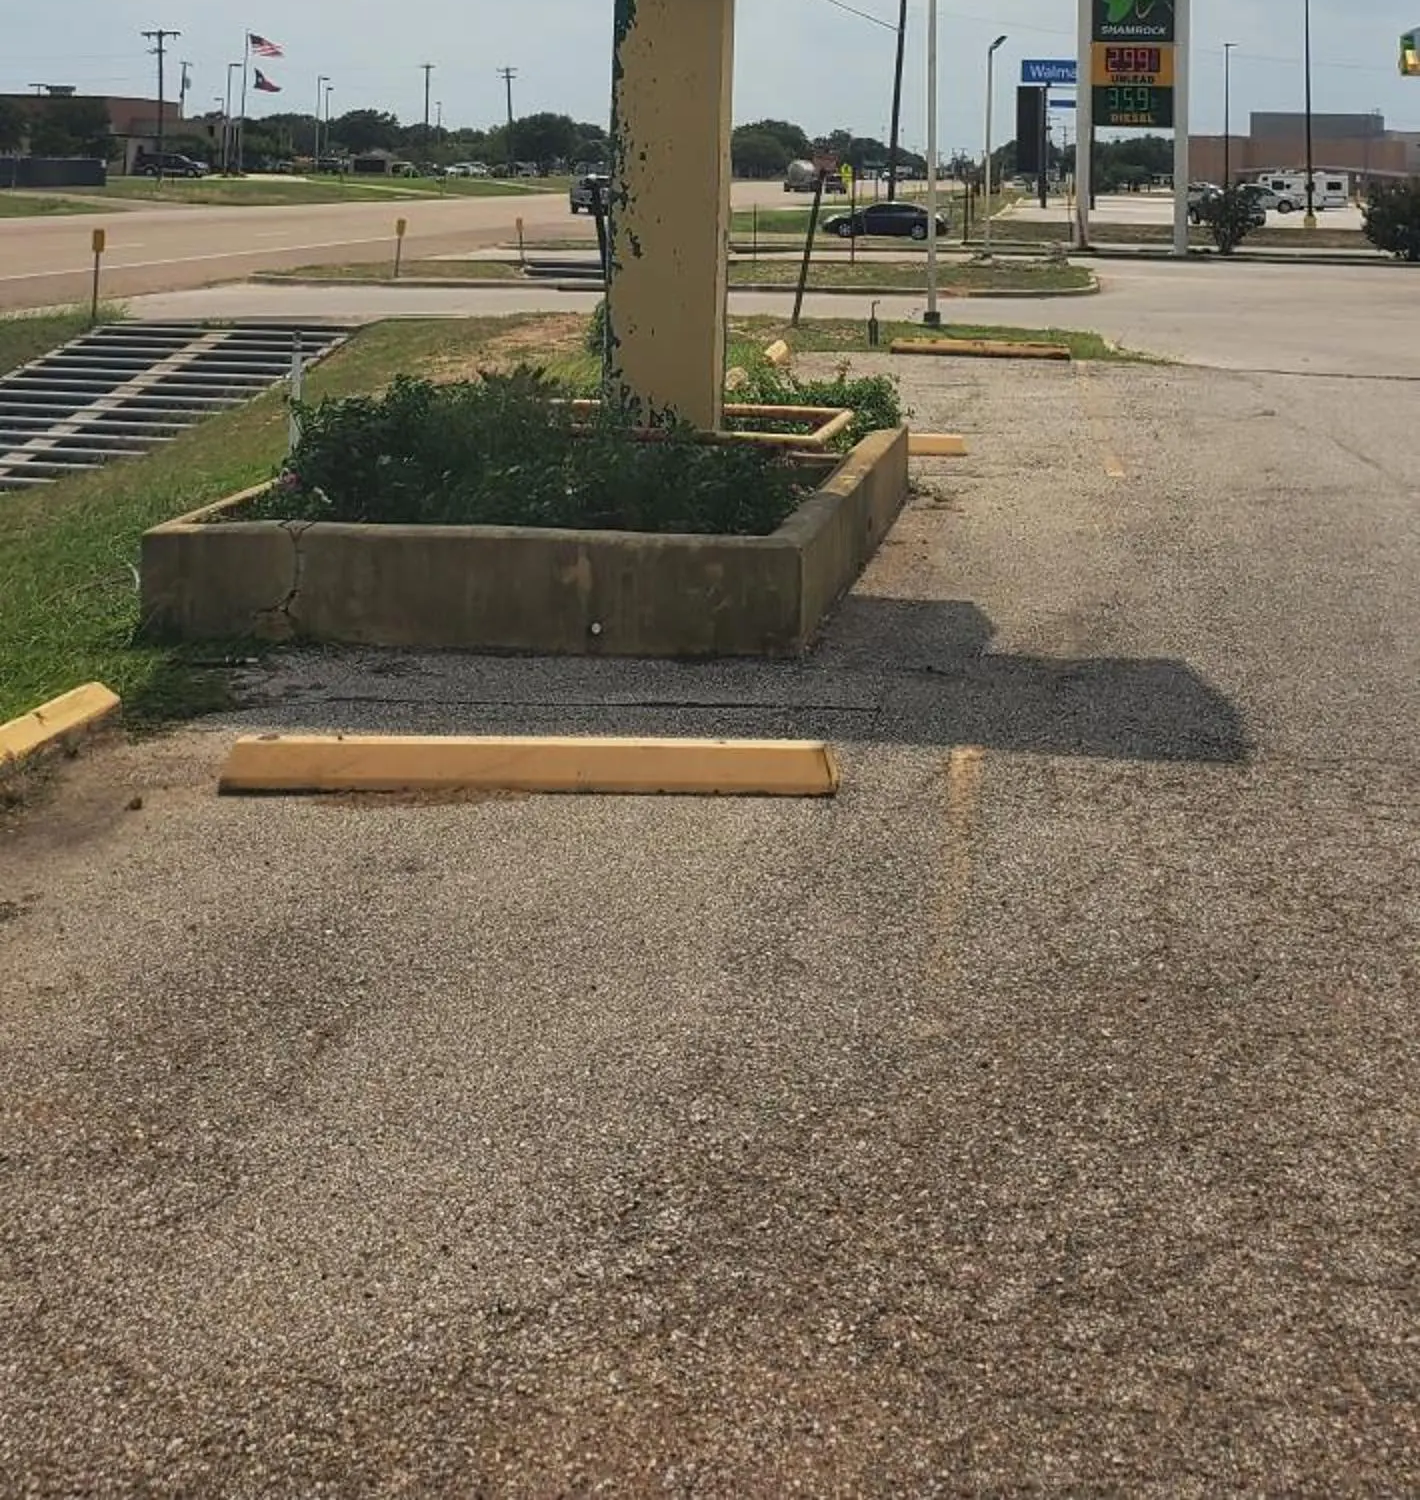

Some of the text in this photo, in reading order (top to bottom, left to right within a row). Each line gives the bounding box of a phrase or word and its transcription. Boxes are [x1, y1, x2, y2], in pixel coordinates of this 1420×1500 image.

[1101, 25, 1166, 35] SHAMROCK
[1111, 75, 1154, 85] UNLEAD
[1111, 113, 1154, 123] DIESEL
